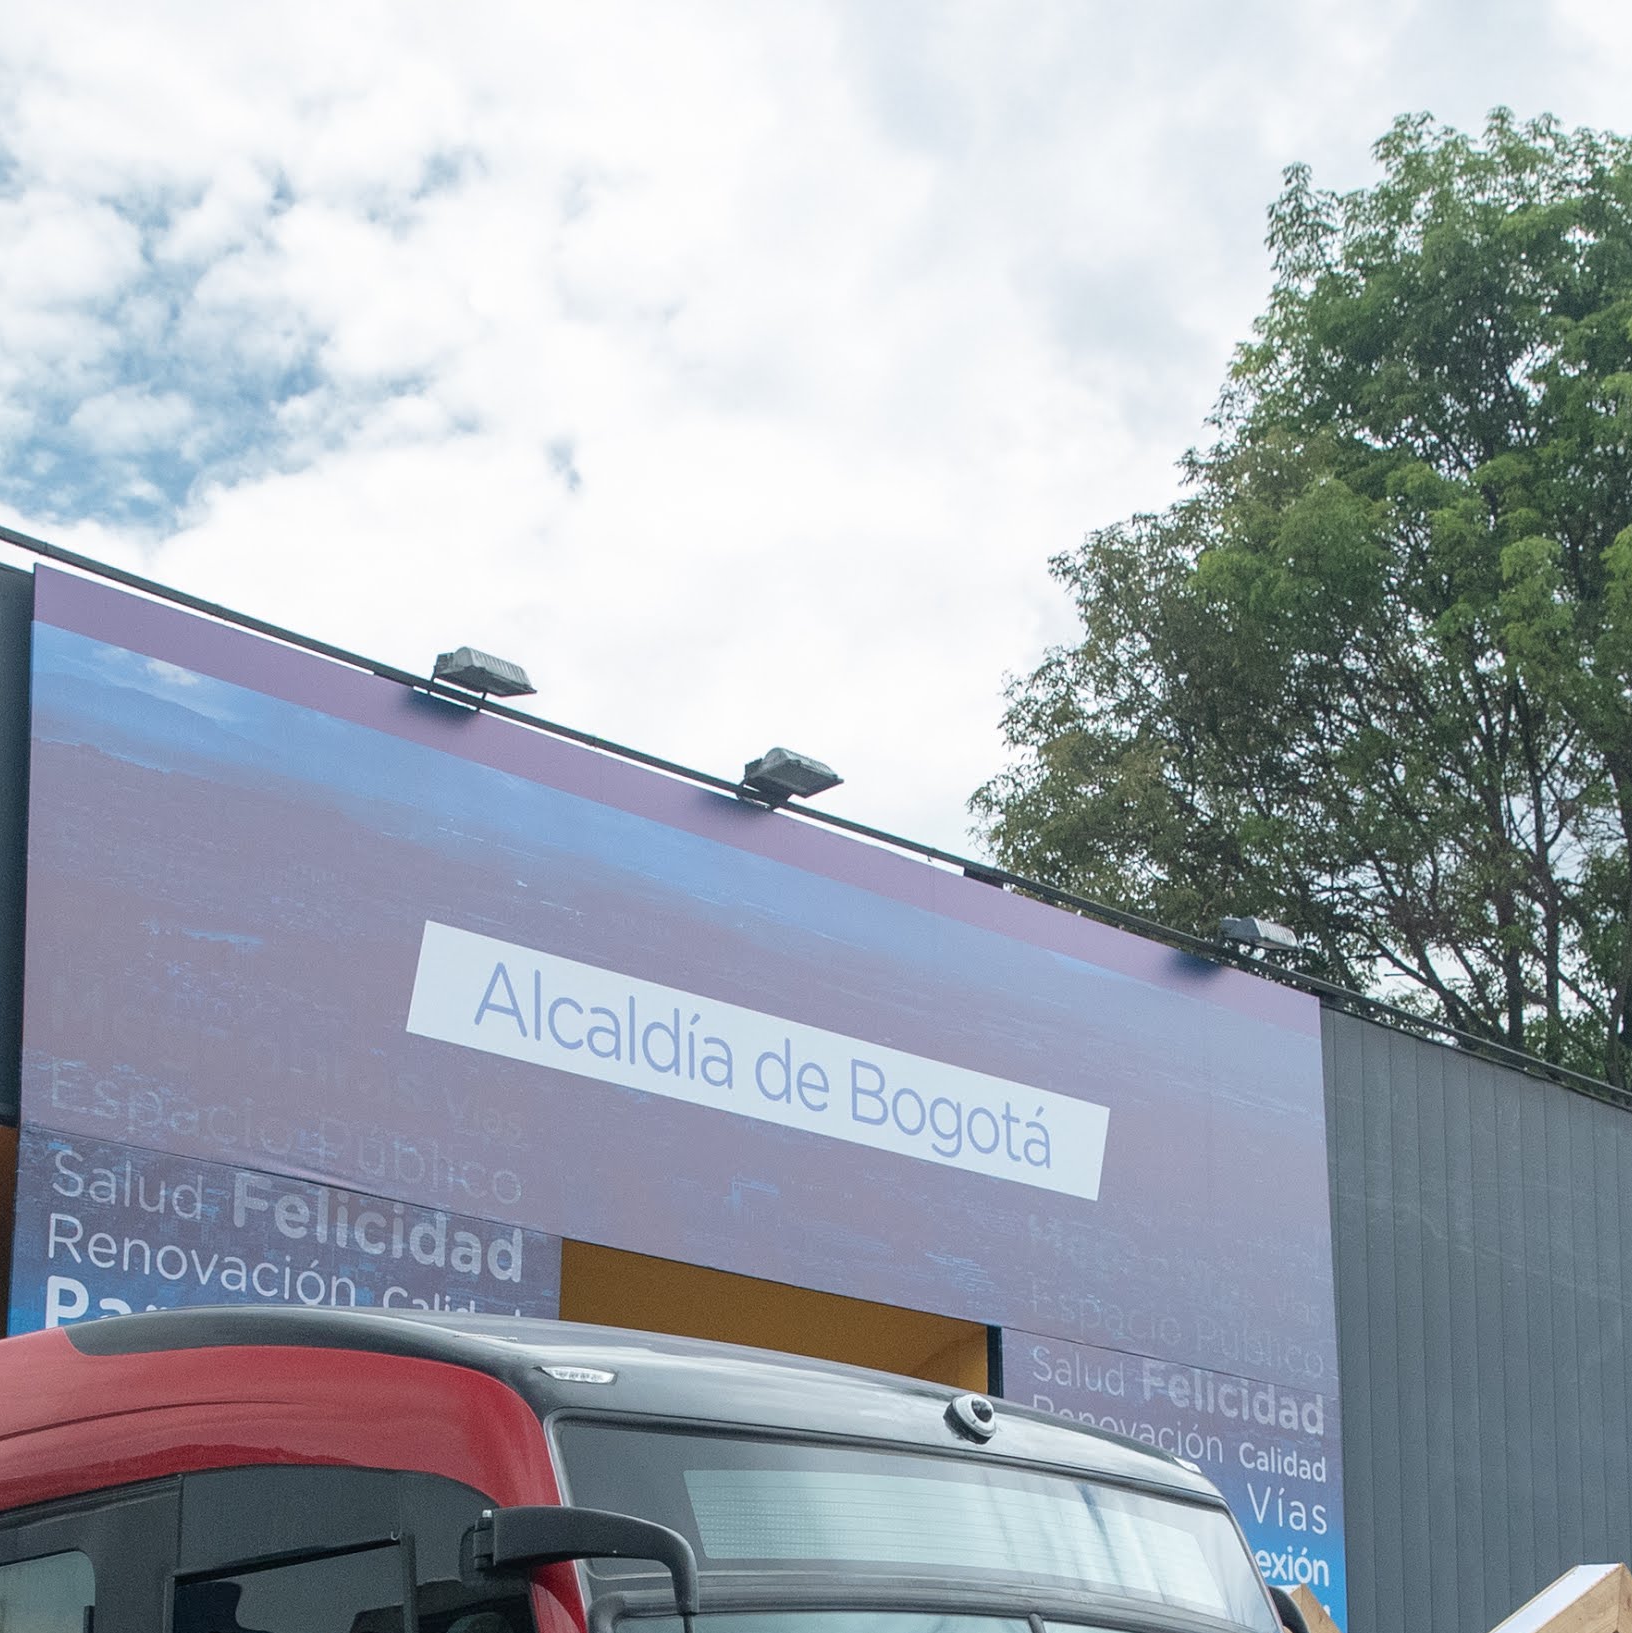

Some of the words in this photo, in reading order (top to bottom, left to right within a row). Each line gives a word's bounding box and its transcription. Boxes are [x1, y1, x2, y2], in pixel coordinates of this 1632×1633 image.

[473, 961, 734, 1090] Alcaldía
[754, 1037, 831, 1113] de
[851, 1057, 1052, 1170] Bogotá
[48, 1212, 357, 1307] Renovación
[51, 1150, 204, 1220] Salud
[232, 1171, 524, 1283] Felicidad
[1031, 1345, 1125, 1397] Salud
[1143, 1360, 1325, 1436] Felicidad
[1239, 1442, 1327, 1483] Calidad
[1247, 1482, 1328, 1536] Vías
